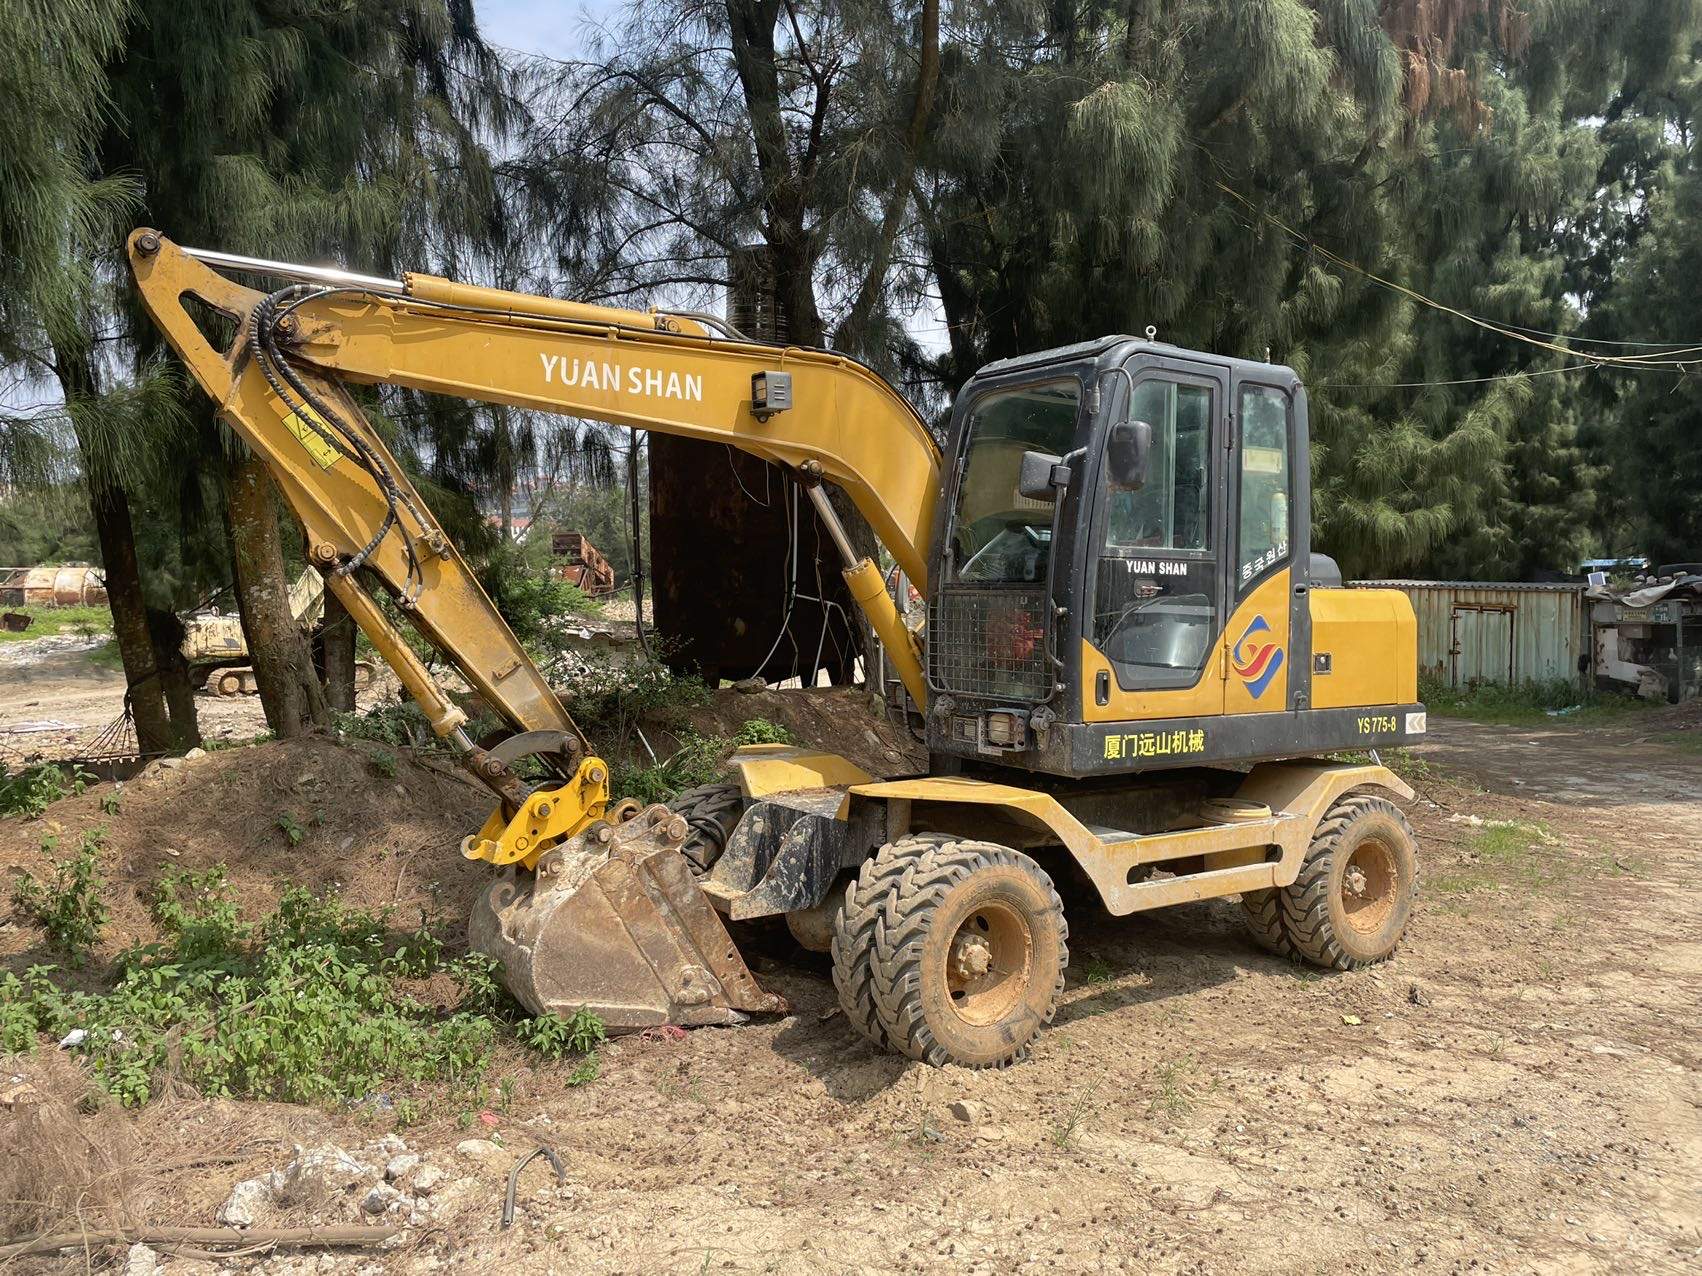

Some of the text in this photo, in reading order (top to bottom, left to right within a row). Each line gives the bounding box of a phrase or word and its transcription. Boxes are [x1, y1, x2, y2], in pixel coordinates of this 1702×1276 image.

[540, 353, 702, 401] YUAN SHAN
[1126, 560, 1188, 576] YUAN SHAN
[1242, 540, 1288, 580] 중국원산
[1104, 729, 1205, 759] 厦门远山机械
